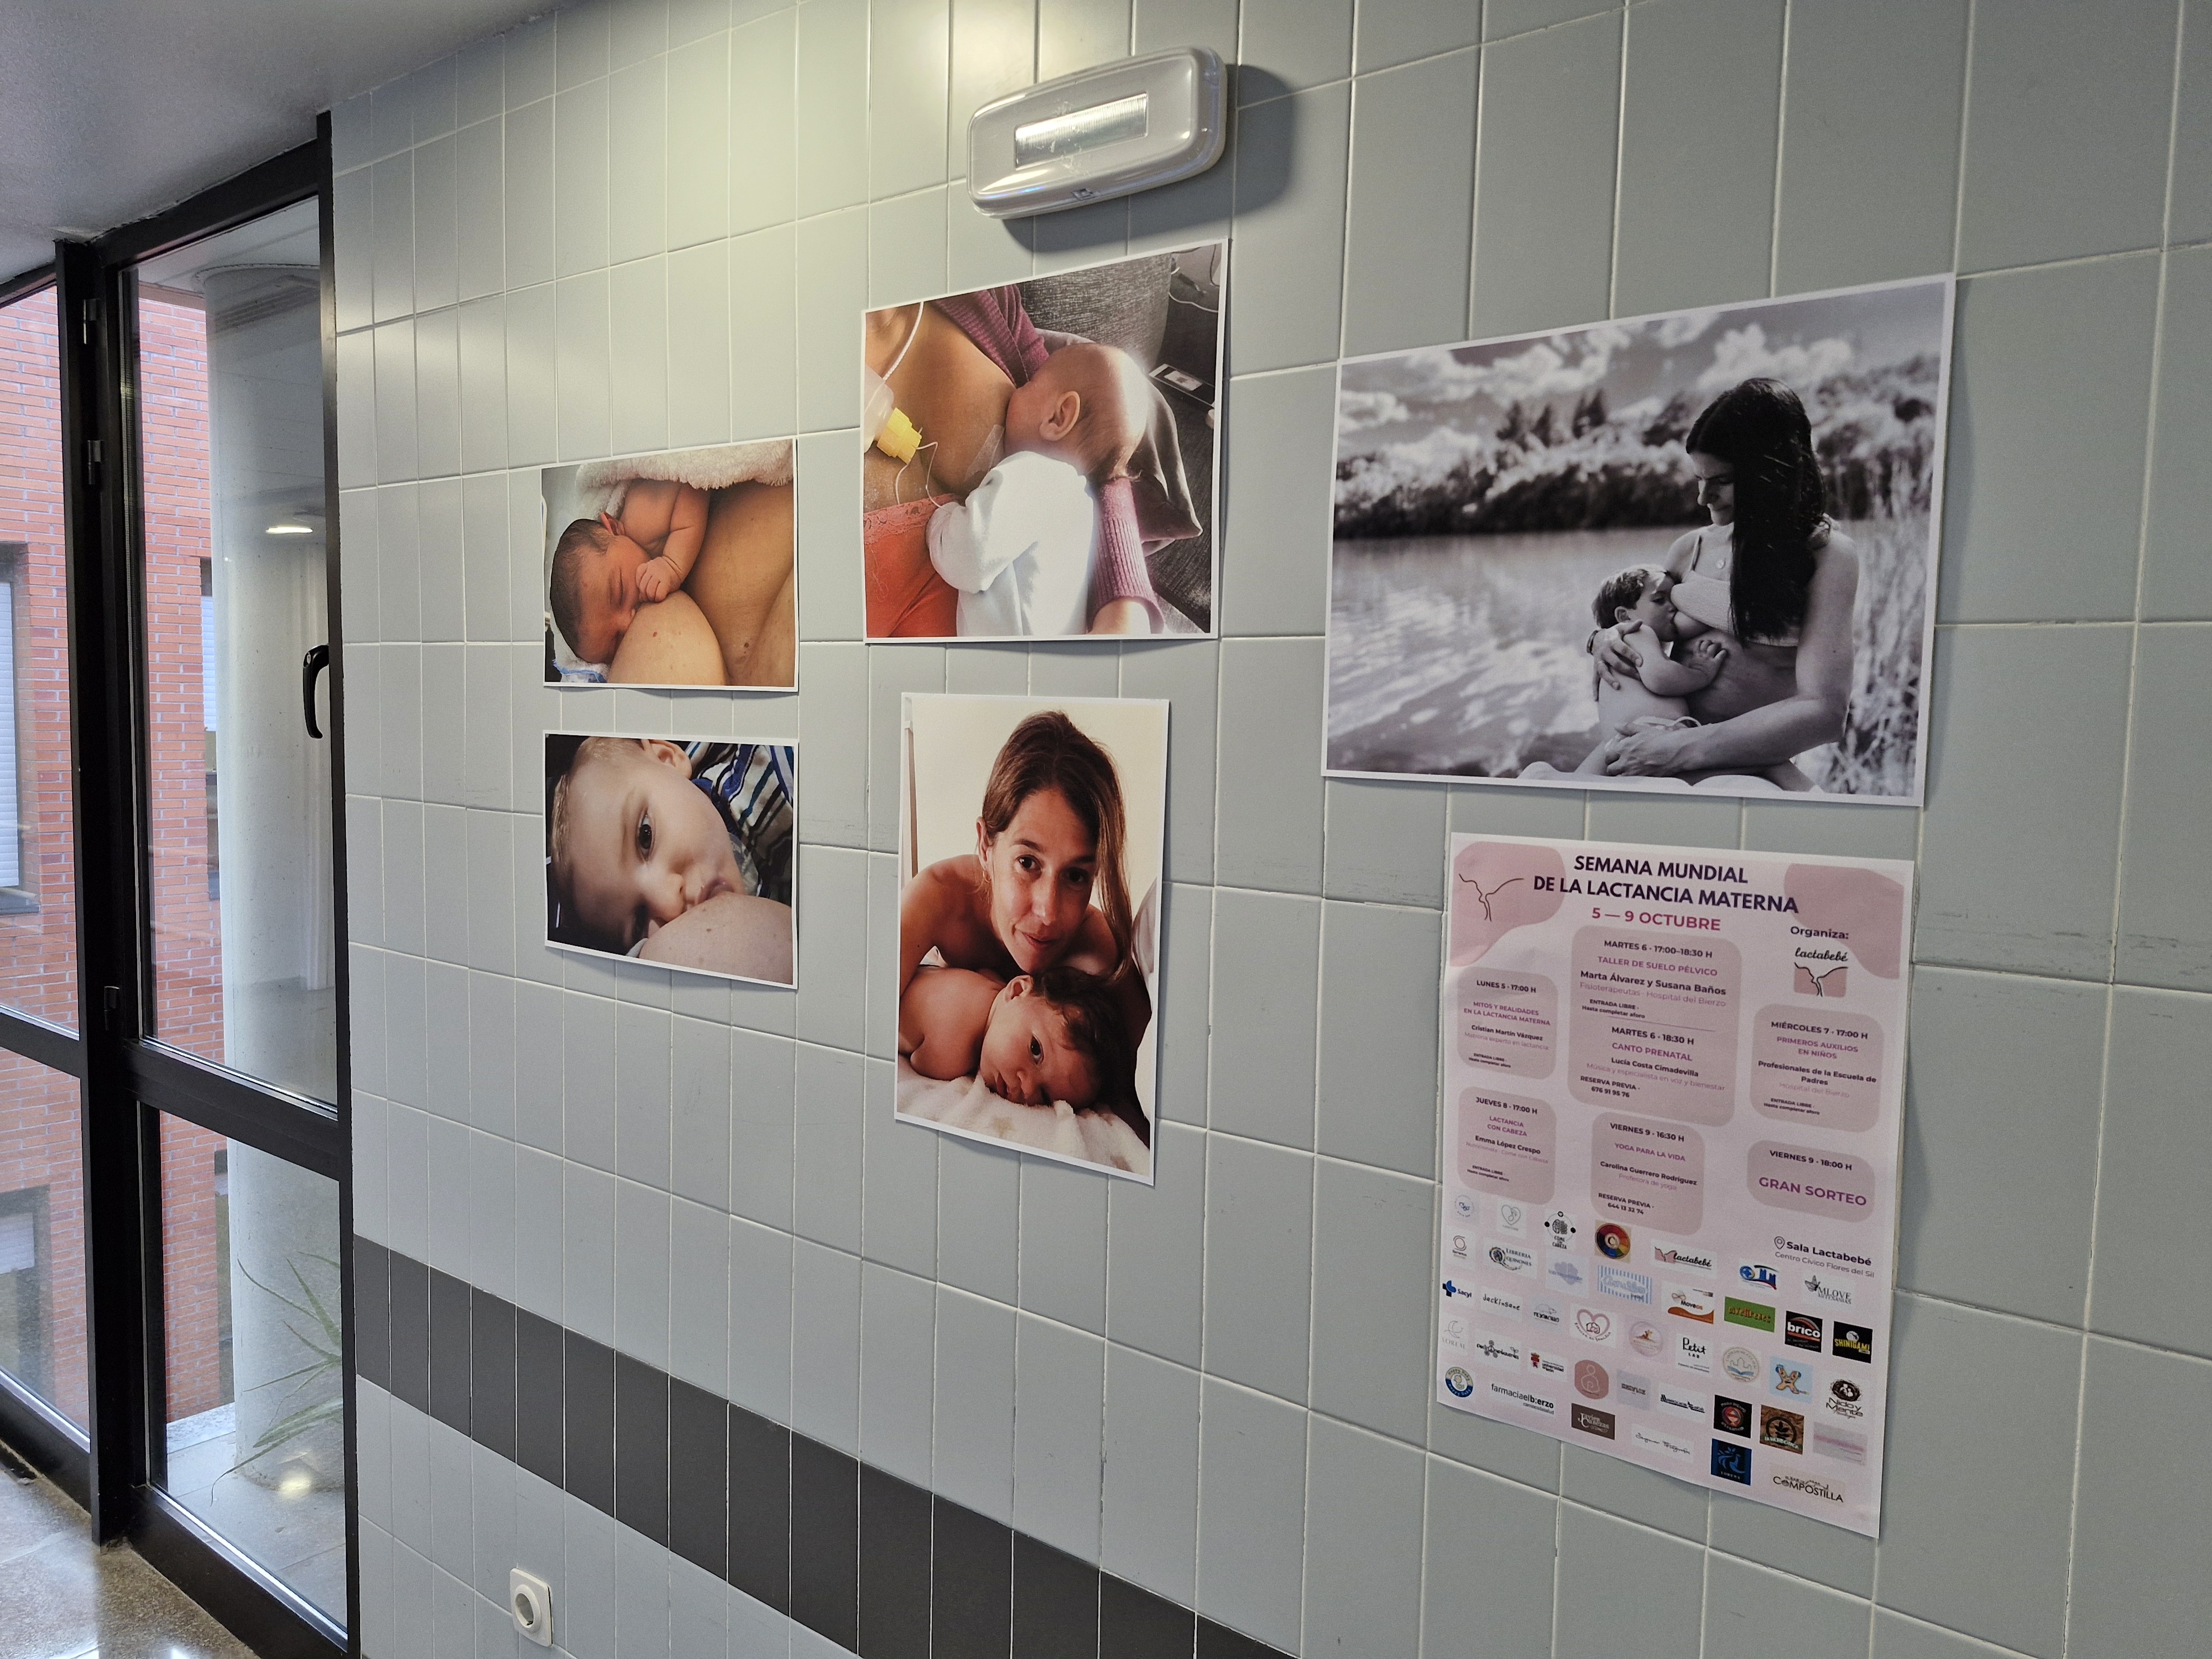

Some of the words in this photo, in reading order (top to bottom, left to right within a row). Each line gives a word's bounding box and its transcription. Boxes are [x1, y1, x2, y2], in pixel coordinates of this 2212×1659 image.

[1574, 855, 1652, 875] SEMANA
[1657, 862, 1749, 884] MUNDIAL
[1534, 876, 1554, 891] DE
[1559, 878, 1582, 894] LA
[1587, 880, 1693, 904] LACTANCIA
[1698, 889, 1799, 914] MATERNA
[1592, 907, 1601, 919] 5
[1625, 911, 1634, 921] 9
[1639, 912, 1721, 931] OCTUBRE
[1791, 926, 1849, 940] Organiza:
[1604, 941, 1639, 950] MARTES
[1794, 947, 1849, 962] lactabebé
[1598, 956, 1629, 966] TALLER
[1646, 962, 1675, 971] SUELO
[1678, 965, 1718, 976] PÉLVICO
[1477, 980, 1499, 988] LUNES
[1580, 971, 1607, 980] Marta
[1610, 972, 1645, 985] Álvarez
[1655, 979, 1691, 991] Susana
[1694, 984, 1726, 995] Baños
[1580, 982, 1640, 997] Fisioterapeutas
[1646, 991, 1681, 1001] Hospital
[1698, 998, 1726, 1007] Bierzo
[1500, 1005, 1539, 1015] REALIDADES
[1589, 999, 1617, 1008] ENTRADA
[1483, 1011, 1517, 1020] LACTANCIA
[1519, 1017, 1550, 1025] MATERNA
[1599, 1008, 1628, 1017] completar
[1472, 1025, 1494, 1033] Cristian
[1517, 1032, 1543, 1041] Vázquez
[1611, 1026, 1647, 1038] MARTES
[1662, 1034, 1684, 1044] 18:30
[1771, 1021, 1822, 1034] MIÉRCOLES
[1836, 1029, 1859, 1038] 17:00
[1612, 1042, 1642, 1053] CANTO
[1645, 1047, 1693, 1061] PRENATAL
[1777, 1036, 1818, 1047] PRIMEROS
[1820, 1042, 1859, 1052] AUXILIOS
[1811, 1050, 1838, 1059] NIÑOS
[1611, 1057, 1630, 1066] Lucía
[1632, 1060, 1653, 1070] Costa
[1655, 1065, 1699, 1077] Cimadevilla
[1759, 1061, 1810, 1073] Profesionales
[1833, 1071, 1864, 1081] Escuela
[1580, 1076, 1610, 1086] RESERVA
[1612, 1080, 1636, 1090] PREVIA
[1801, 1076, 1828, 1085] Padres
[1475, 1097, 1501, 1107] JUEVES
[1513, 1104, 1530, 1113] 17:00
[1489, 1116, 1524, 1127] LACTANCIA
[1503, 1127, 1527, 1136] CABEZA
[1610, 1123, 1644, 1134] VIERNES
[1656, 1131, 1676, 1140] 16:30
[1475, 1135, 1495, 1145] Emma
[1497, 1140, 1516, 1149] López
[1517, 1145, 1541, 1155] Crespo
[1615, 1143, 1635, 1151] YOGA
[1636, 1147, 1655, 1155] PARA
[1770, 1150, 1807, 1162] VIERNES
[1821, 1160, 1843, 1168] 18:00
[1600, 1161, 1628, 1172] Carolina
[1630, 1167, 1660, 1177] Guerrero
[1661, 1173, 1697, 1186] Rodríguez
[1759, 1177, 1801, 1193] GRAN
[1805, 1186, 1867, 1206] SORTEO
[1598, 1193, 1626, 1203] RESERVA
[1628, 1199, 1651, 1208] PREVIA
[1673, 1251, 1712, 1267] lactabebé
[1787, 1241, 1809, 1253] Sala
[1812, 1246, 1872, 1266] Lactabebé
[1775, 1252, 1801, 1261] Centro
[1802, 1257, 1825, 1266] Cívico
[1827, 1262, 1849, 1272] Flores
[1851, 1267, 1863, 1275] del
[1865, 1270, 1875, 1278] Sil
[1458, 1288, 1472, 1298] Sacyl
[1483, 1294, 1520, 1310] Jackinsane
[1787, 1321, 1820, 1338] brico
[1682, 1337, 1706, 1354] Petit
